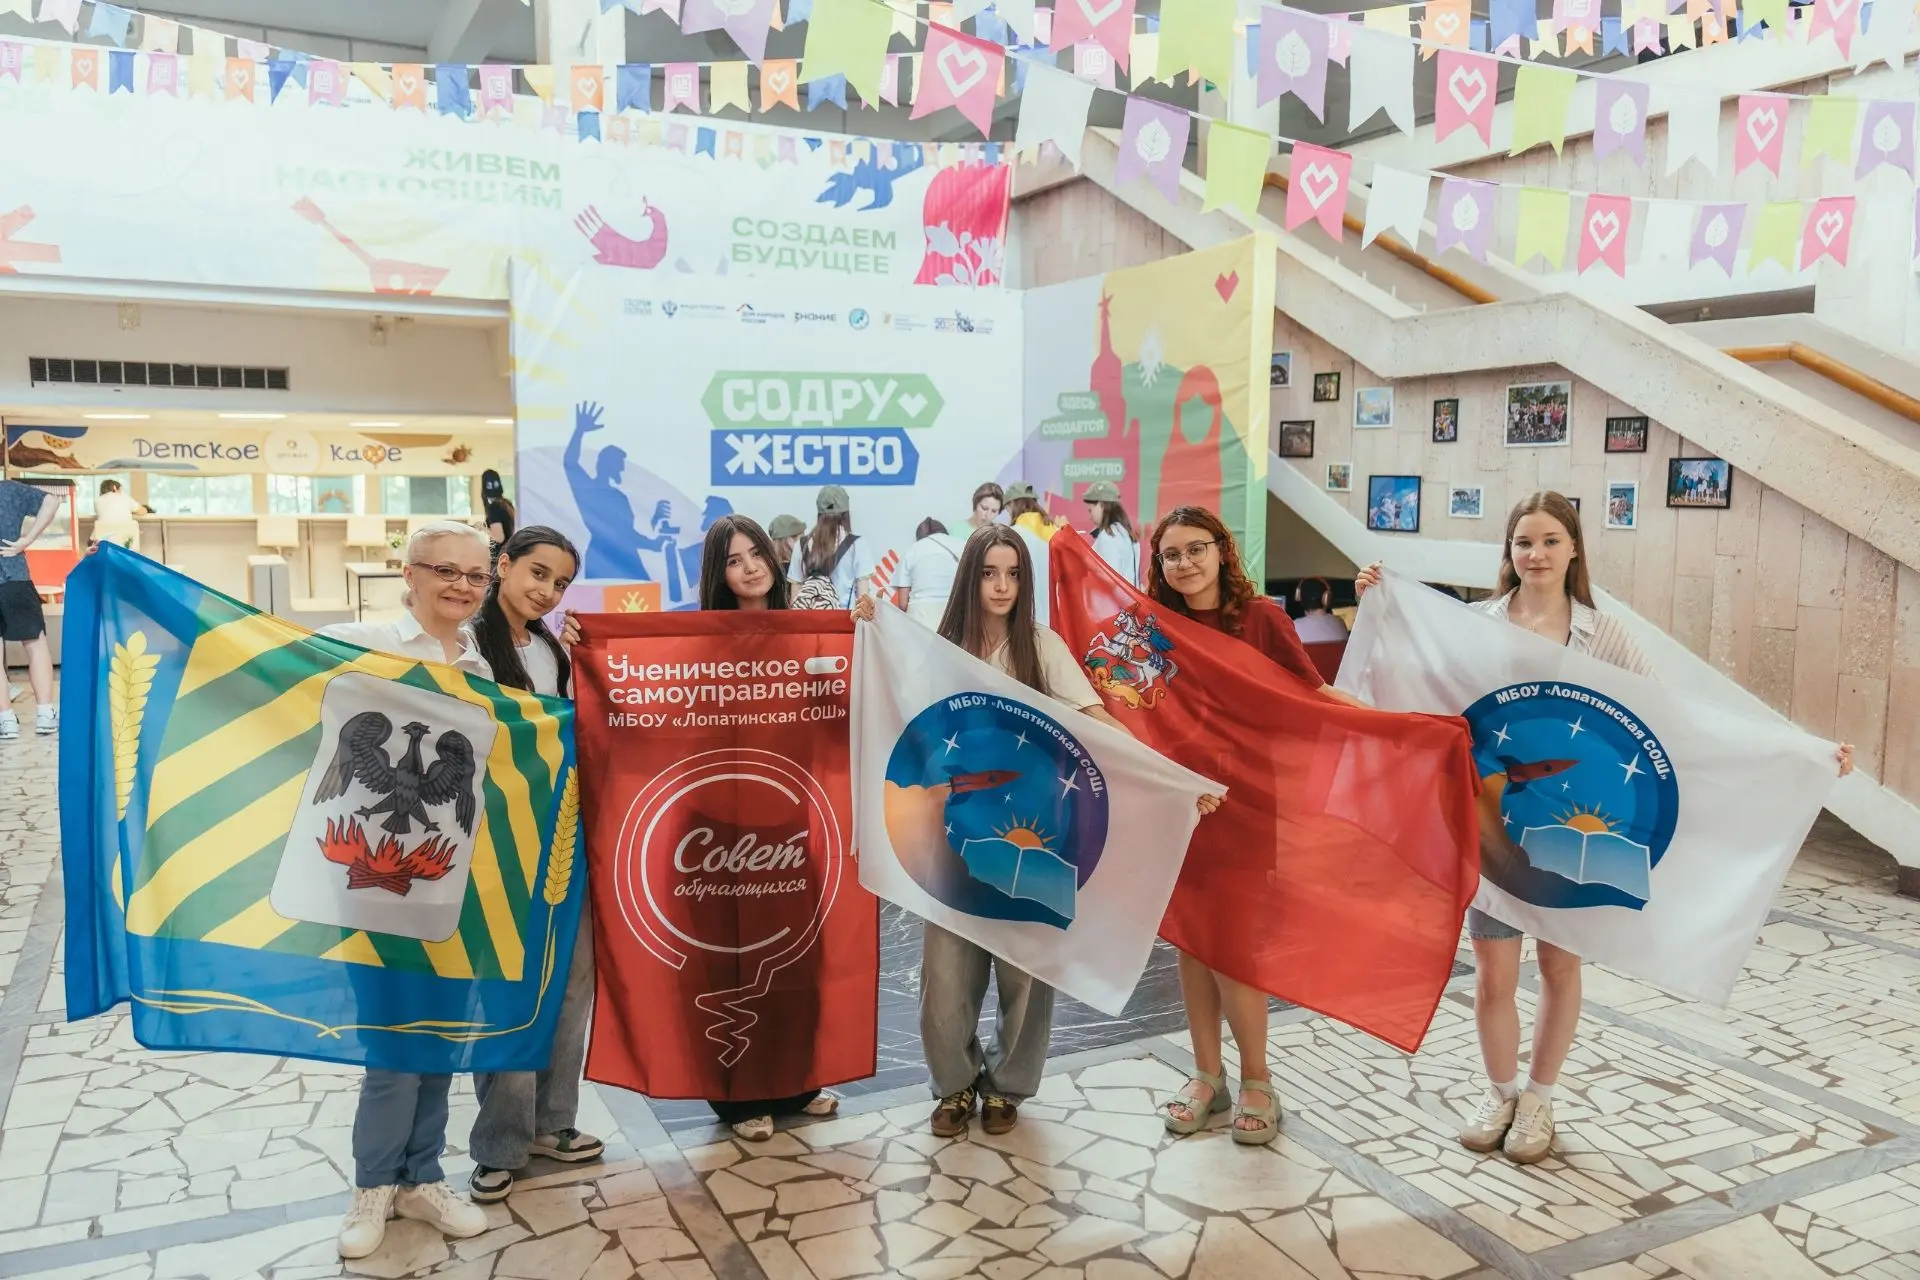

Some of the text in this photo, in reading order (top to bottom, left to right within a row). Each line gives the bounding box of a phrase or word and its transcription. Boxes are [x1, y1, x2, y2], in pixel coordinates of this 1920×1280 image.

[403, 147, 562, 182] ЖИВЕМ
[276, 163, 563, 210] НАСТОЯЩИМ
[732, 216, 897, 250] СОЗДАЕМ
[731, 243, 890, 274] БУДУЩЕЕ
[722, 378, 899, 427] СОДРУ
[1060, 396, 1097, 410] ЗДЕСЬ
[1042, 418, 1105, 435] СОЗДАЕТСЯ
[132, 438, 260, 461] Детское
[724, 433, 904, 475] ЖЕСТВО
[1064, 462, 1123, 477] ЕДИНСТВО
[607, 654, 800, 683] Ученическое
[608, 679, 847, 708] самоуправление
[608, 704, 847, 728] МБОУ «Лопатинская СОШ»
[948, 695, 1105, 799] МБОУ «Лопатинская СОШ»
[1495, 684, 1671, 781] МБОУ «Лопатинская СОШ»
[673, 827, 810, 874] Совет
[673, 878, 808, 902] обучающихся
